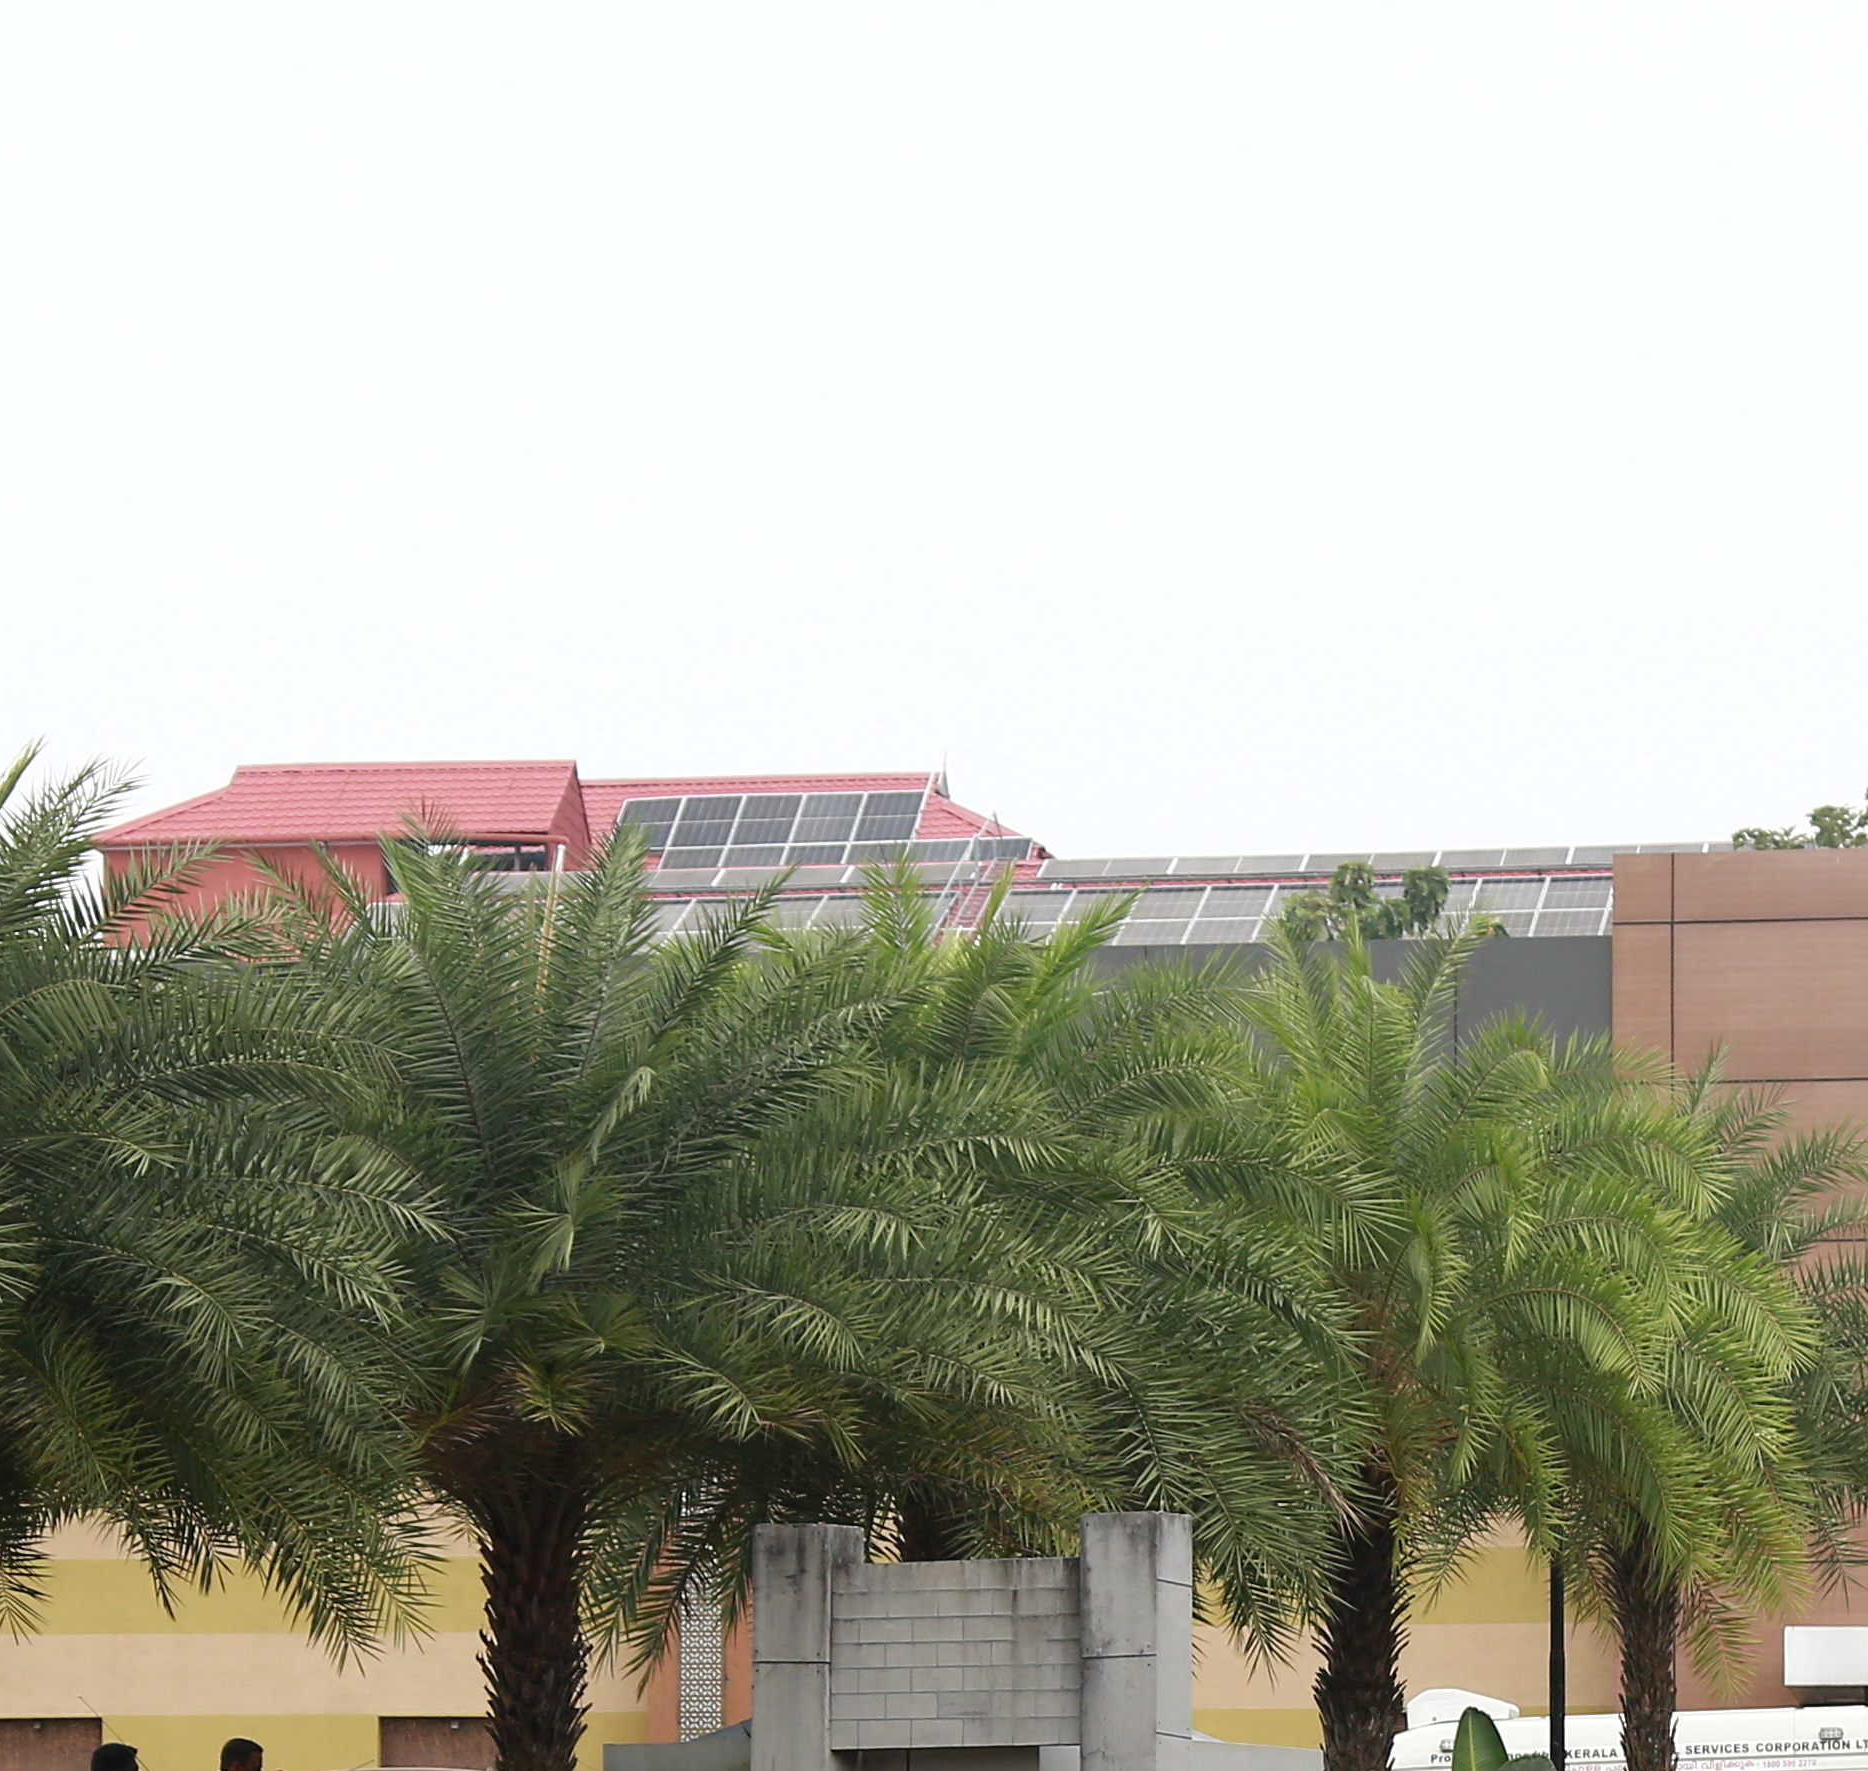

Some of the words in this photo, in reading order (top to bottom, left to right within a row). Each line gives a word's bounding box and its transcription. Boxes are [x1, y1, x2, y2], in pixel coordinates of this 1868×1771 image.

[1565, 1748, 1618, 1759] KERALA
[1685, 1743, 1750, 1755] SERVICES
[1756, 1740, 1851, 1753] CORPORATION
